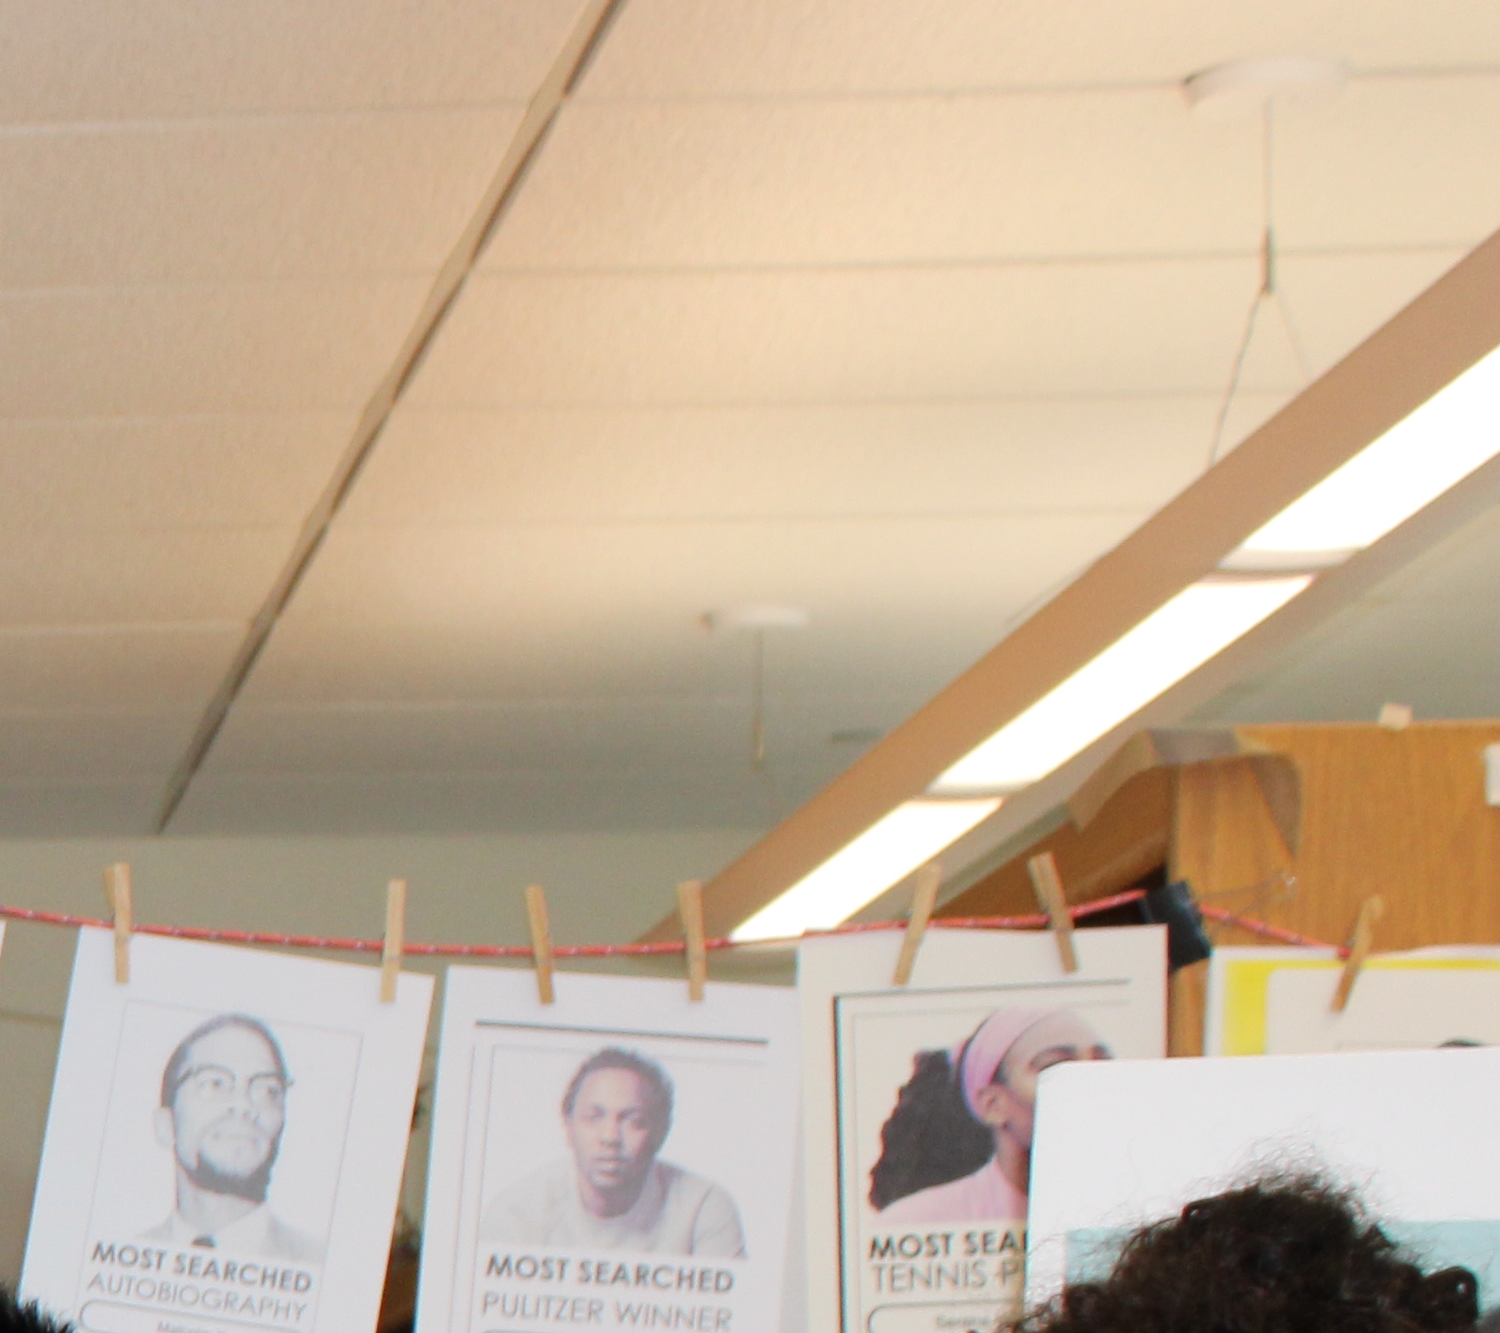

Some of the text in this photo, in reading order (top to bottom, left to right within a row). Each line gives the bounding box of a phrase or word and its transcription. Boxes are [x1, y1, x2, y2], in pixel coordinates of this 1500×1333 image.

[870, 1232, 954, 1259] MOST
[91, 1241, 312, 1293] MOST SEARCHED
[486, 1255, 734, 1293] MOST SEARCHED
[872, 1259, 987, 1292] TENNIS
[87, 1272, 307, 1320] AUTOBIOGRAPHY
[481, 1291, 732, 1332] PULITZER WINNER
